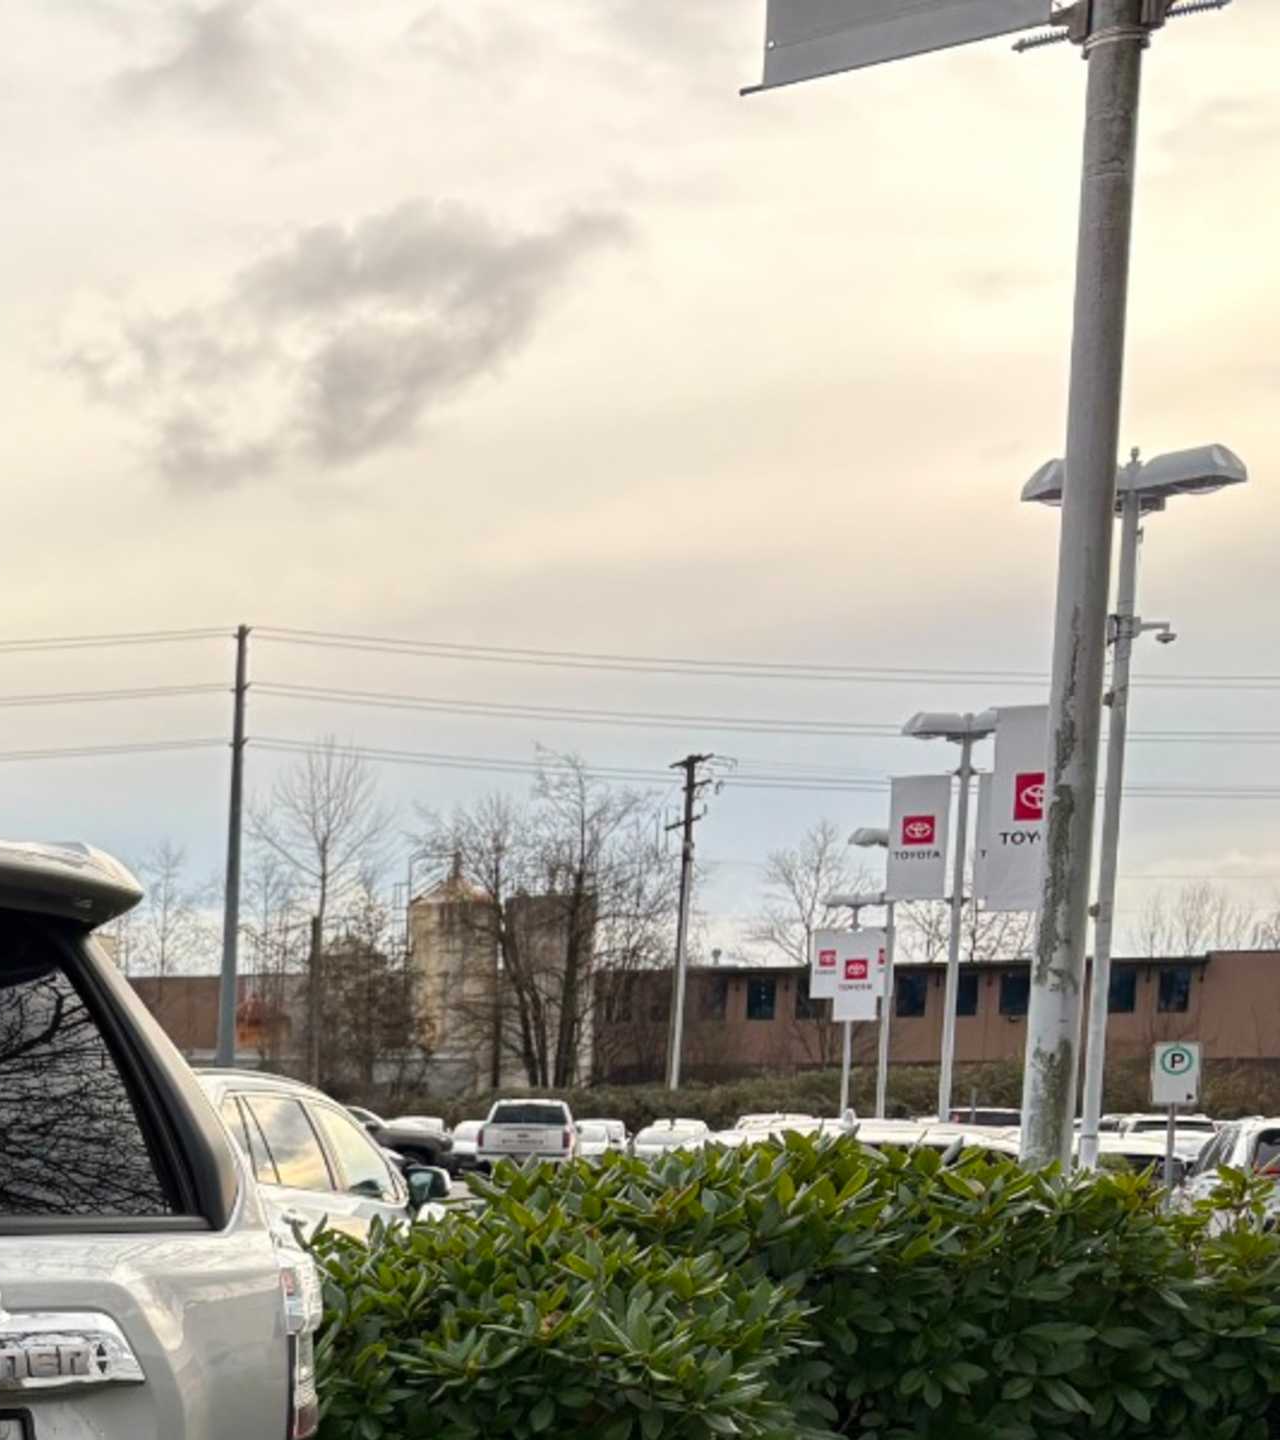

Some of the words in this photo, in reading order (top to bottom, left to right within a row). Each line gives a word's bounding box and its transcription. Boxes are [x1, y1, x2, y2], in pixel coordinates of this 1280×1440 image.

[1000, 832, 1041, 846] TOY
[894, 850, 940, 860] TOYOTA
[1170, 1053, 1185, 1069] P
